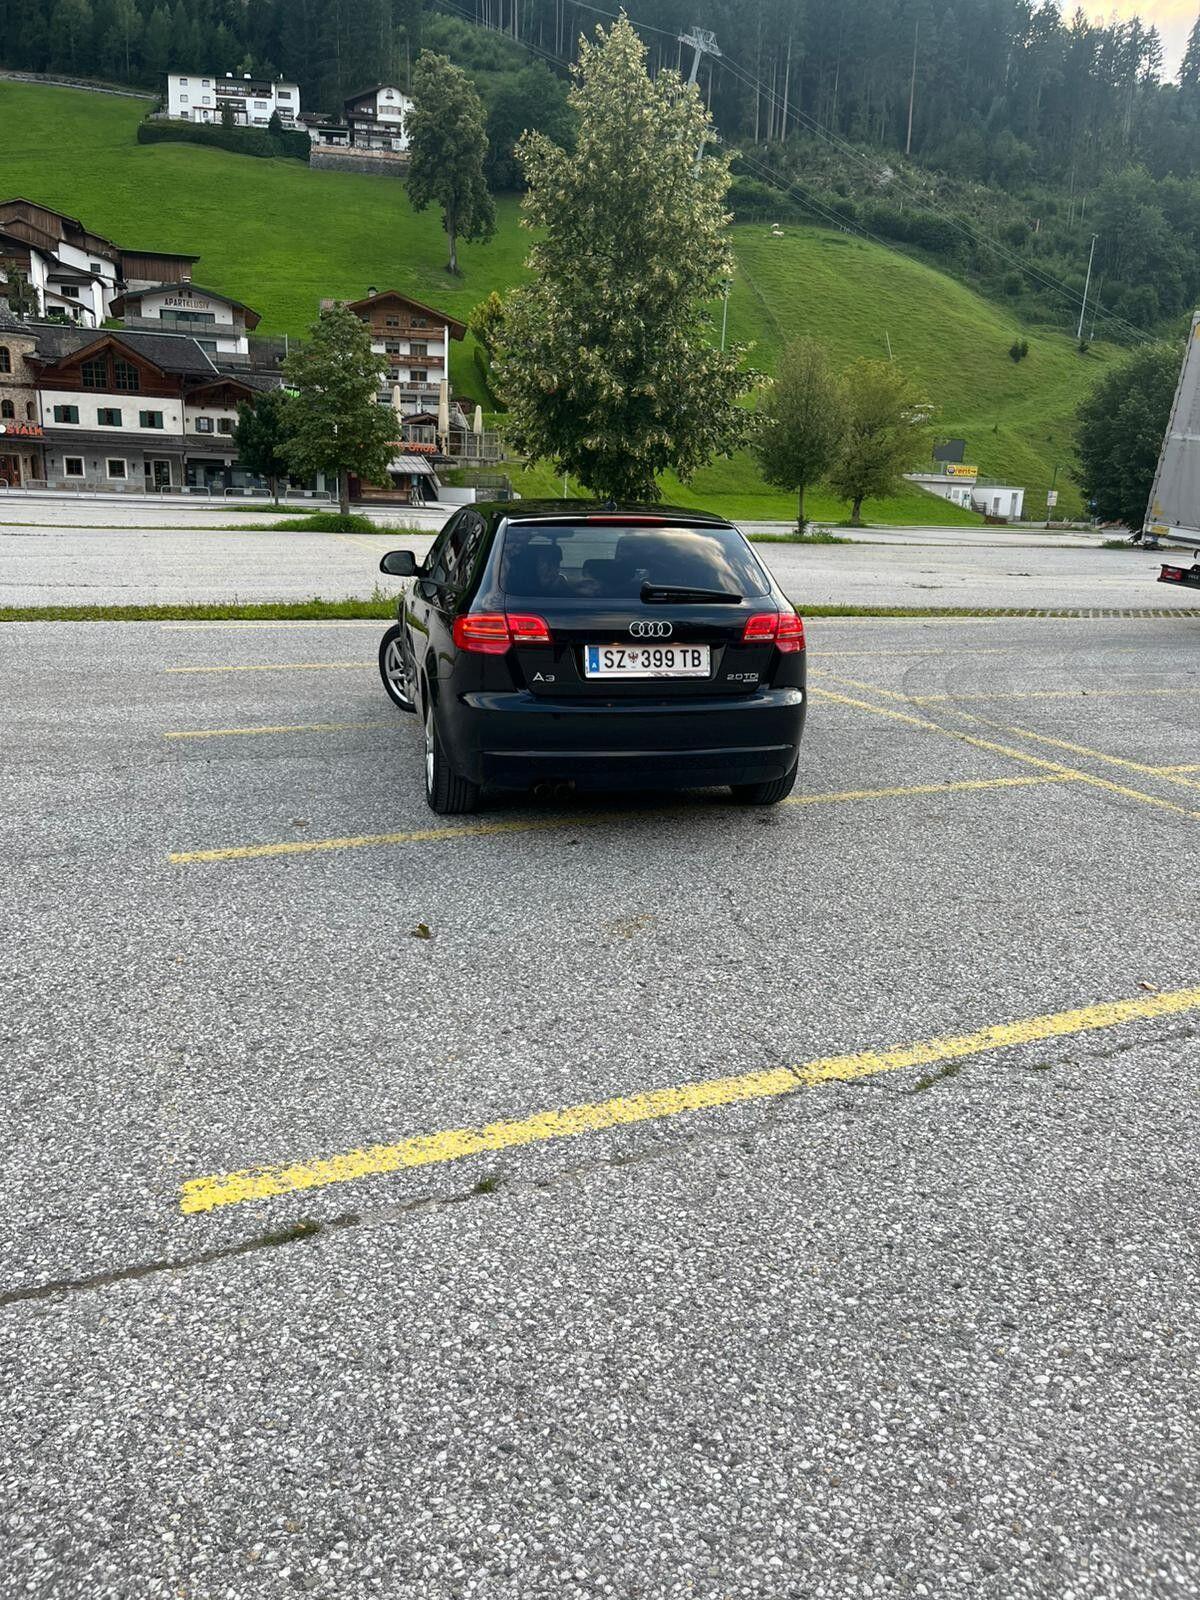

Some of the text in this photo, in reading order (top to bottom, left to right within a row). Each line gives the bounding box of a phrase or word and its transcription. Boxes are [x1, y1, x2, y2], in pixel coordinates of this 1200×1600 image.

[604, 649, 702, 669] SZ 399 TB
[532, 671, 555, 682] A3
